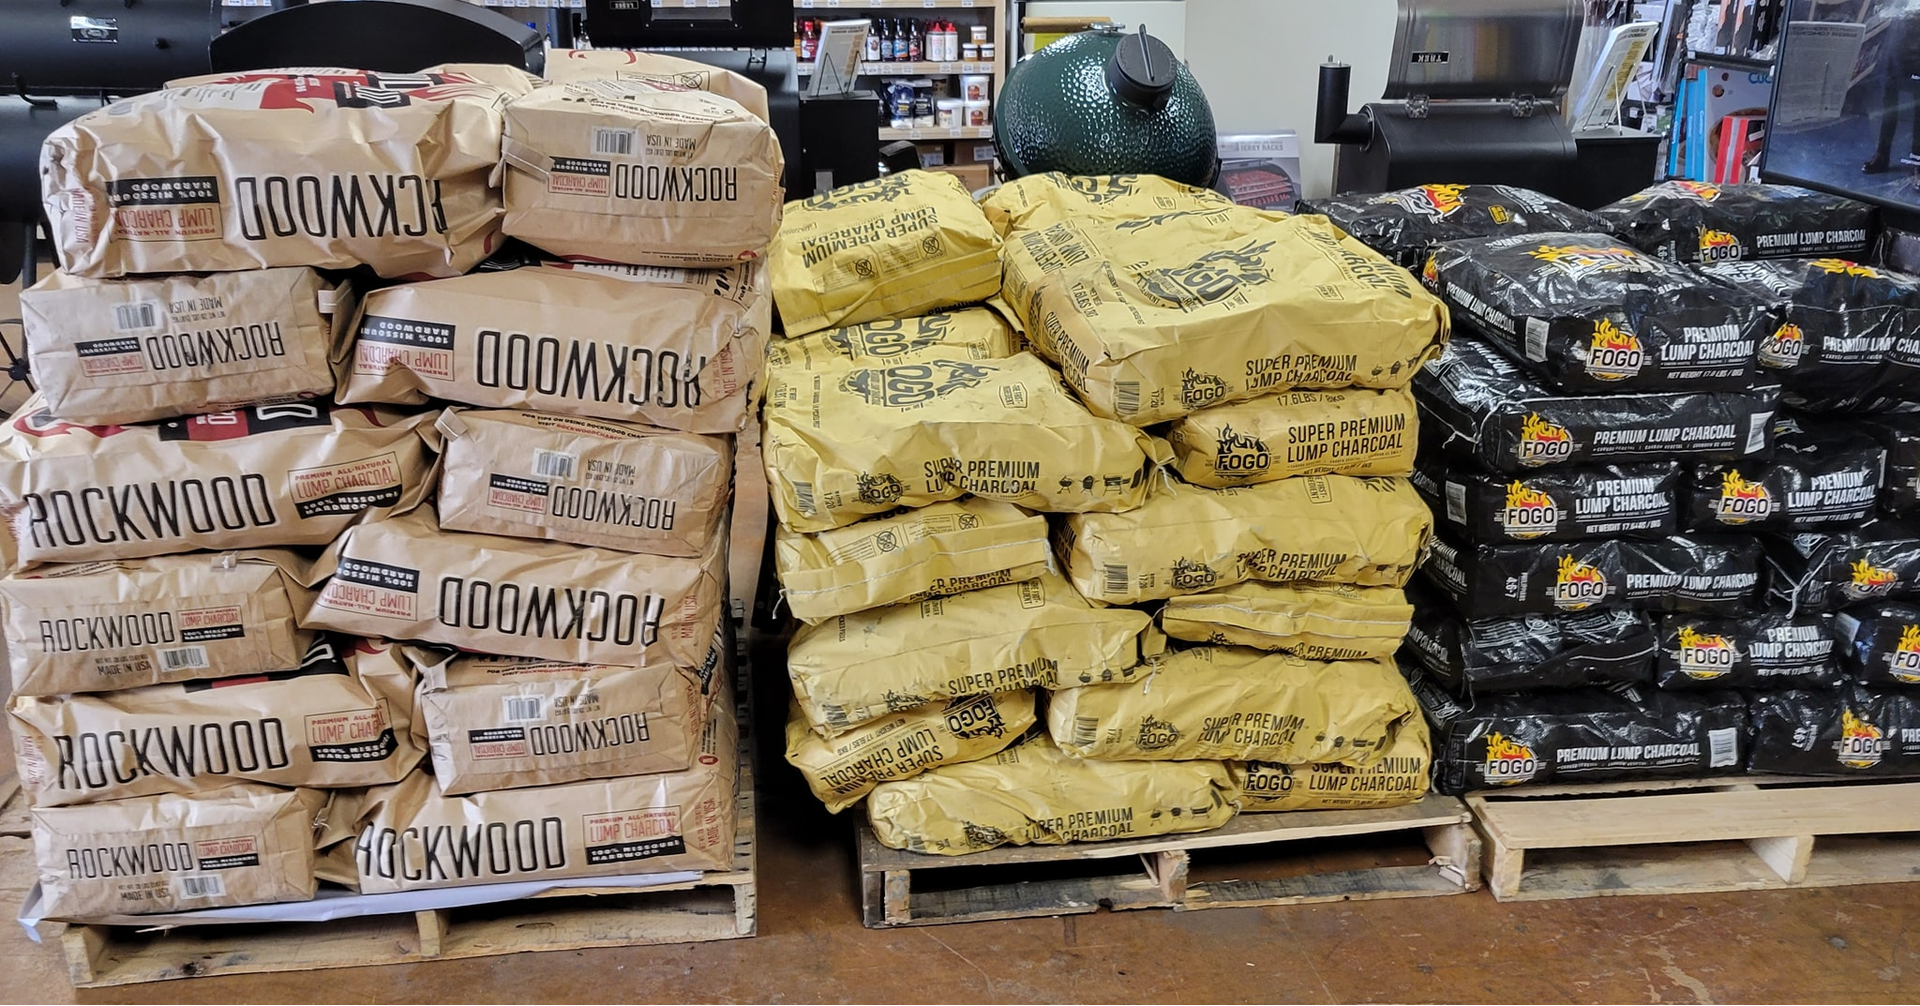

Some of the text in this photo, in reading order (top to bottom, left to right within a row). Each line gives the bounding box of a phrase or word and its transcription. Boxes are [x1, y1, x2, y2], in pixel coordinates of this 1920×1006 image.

[647, 134, 697, 150] MADE IN USA
[132, 181, 212, 192] HARDWOOD
[552, 174, 607, 188] LUMP CHARCOAL
[616, 163, 737, 201] ROCKWOOD
[180, 190, 213, 199] 100%
[178, 207, 215, 226] LUMP
[75, 226, 89, 243] USA
[175, 227, 216, 235] PREMIUM
[800, 206, 938, 252] LUMP CHARCOAL
[1756, 228, 1867, 249] PREMIUM LUMP CHARCOAL
[803, 214, 938, 269] SUPER PREMIUM
[1701, 244, 1741, 262] FOGO
[169, 296, 223, 314] MADE IN USA
[1446, 281, 1517, 336] PREMIUM CHARCOAL
[360, 326, 450, 345] 100% MISSOURI
[380, 321, 450, 336] HARDWOOD
[1683, 324, 1741, 343] PREMIUM
[147, 322, 285, 370] ROCKWOOD
[1057, 329, 1091, 376] PREMIUM
[1661, 340, 1756, 361] LUMP CHARCOAL
[414, 350, 450, 370] LUMP
[1246, 354, 1358, 377] SUPER PREMIUM
[1590, 348, 1641, 369] FOGO
[1286, 368, 1353, 385] CHARCOAL
[1667, 371, 1681, 380] NET
[1681, 370, 1702, 380] WEIGHT
[1183, 385, 1225, 402] FOGO
[1276, 393, 1316, 407] 17.6LBS
[1288, 413, 1407, 445] SUPER PREMIUM
[1593, 424, 1737, 445] PREMIUM LUMP CHARCOAL
[1287, 444, 1329, 464] LUMP
[1332, 433, 1404, 459] CHARCOAL
[1521, 440, 1571, 457] FOGO
[294, 458, 393, 483] PREMIUM ALL-NATURAL
[587, 459, 636, 477] MADE USA
[967, 460, 1040, 479] PREMIUM
[1216, 453, 1270, 472] FOGO
[296, 465, 398, 500] LUMP CHARCOAL
[959, 476, 1038, 494] CHARCOAL
[1596, 477, 1655, 496] PREMIUM
[1810, 471, 1865, 490] PREMIUM
[303, 489, 401, 511] 100% MISSOURI
[1575, 498, 1611, 515] LUMP
[1612, 491, 1670, 512] CHARCOAL
[1788, 484, 1877, 508] LUMP CHARCOAL
[23, 473, 276, 548] ROCKWOOD
[552, 486, 676, 530] ROCKWOOD
[1507, 506, 1557, 525] FOGO
[1720, 497, 1768, 515] FOGO
[1586, 525, 1599, 534] NET
[1599, 523, 1621, 533] WEIGHT
[1279, 552, 1348, 569] PREMIUM
[344, 561, 415, 580] HARDWOOD
[1173, 572, 1215, 587] FOGO
[381, 575, 414, 588] 100%
[1557, 581, 1606, 599] FOGO
[1626, 573, 1711, 590] PREMIUM LUMP
[373, 590, 413, 610] LUMP
[685, 595, 697, 610] USA
[376, 605, 412, 617] PREMIUM
[439, 576, 664, 647] ROCKWOOD
[40, 611, 175, 652] ROCKWOOD
[1766, 625, 1819, 642] PREMIUM
[1683, 647, 1732, 664] FOGO
[1749, 642, 1785, 659] LUMP
[97, 661, 152, 676] MADE IN USA
[948, 657, 1059, 696] SUPER PREMIUM
[311, 716, 349, 726] PREMIUM
[949, 698, 998, 734] FOGO
[1203, 712, 1305, 732] SUPER PREMIUM
[312, 724, 345, 744] LUMP
[531, 712, 649, 756] ROCKWOOD
[1139, 733, 1179, 745] FOGO
[1234, 728, 1296, 746] CHARCOAL
[54, 717, 289, 790] ROCKWOOD
[317, 749, 388, 760] HARDWOOD
[1556, 745, 1609, 764] PREMIUM
[1611, 745, 1642, 761] LUMP
[1643, 742, 1701, 760] CHARCOAL
[1842, 736, 1883, 754] FOGO
[820, 728, 938, 788] LUMP CHARCOAL
[898, 746, 944, 775] SUPER
[1487, 758, 1535, 776] FOGO
[1245, 774, 1294, 791] FOGO
[1309, 775, 1419, 792] LUMP CHARCOAL
[589, 810, 677, 825] PREMIUM ALL-NATURAL
[704, 798, 720, 847] MADE USA
[1068, 807, 1134, 829] PREMIUM
[589, 818, 677, 843] LUMP CHARCOAL
[1062, 822, 1135, 841] CHARCOAL
[355, 816, 566, 880] ROCKWOOD
[591, 840, 680, 856] 100% MISSOURI
[591, 848, 660, 862] HARDWOOD
[67, 842, 193, 880] ROCKWOOD
